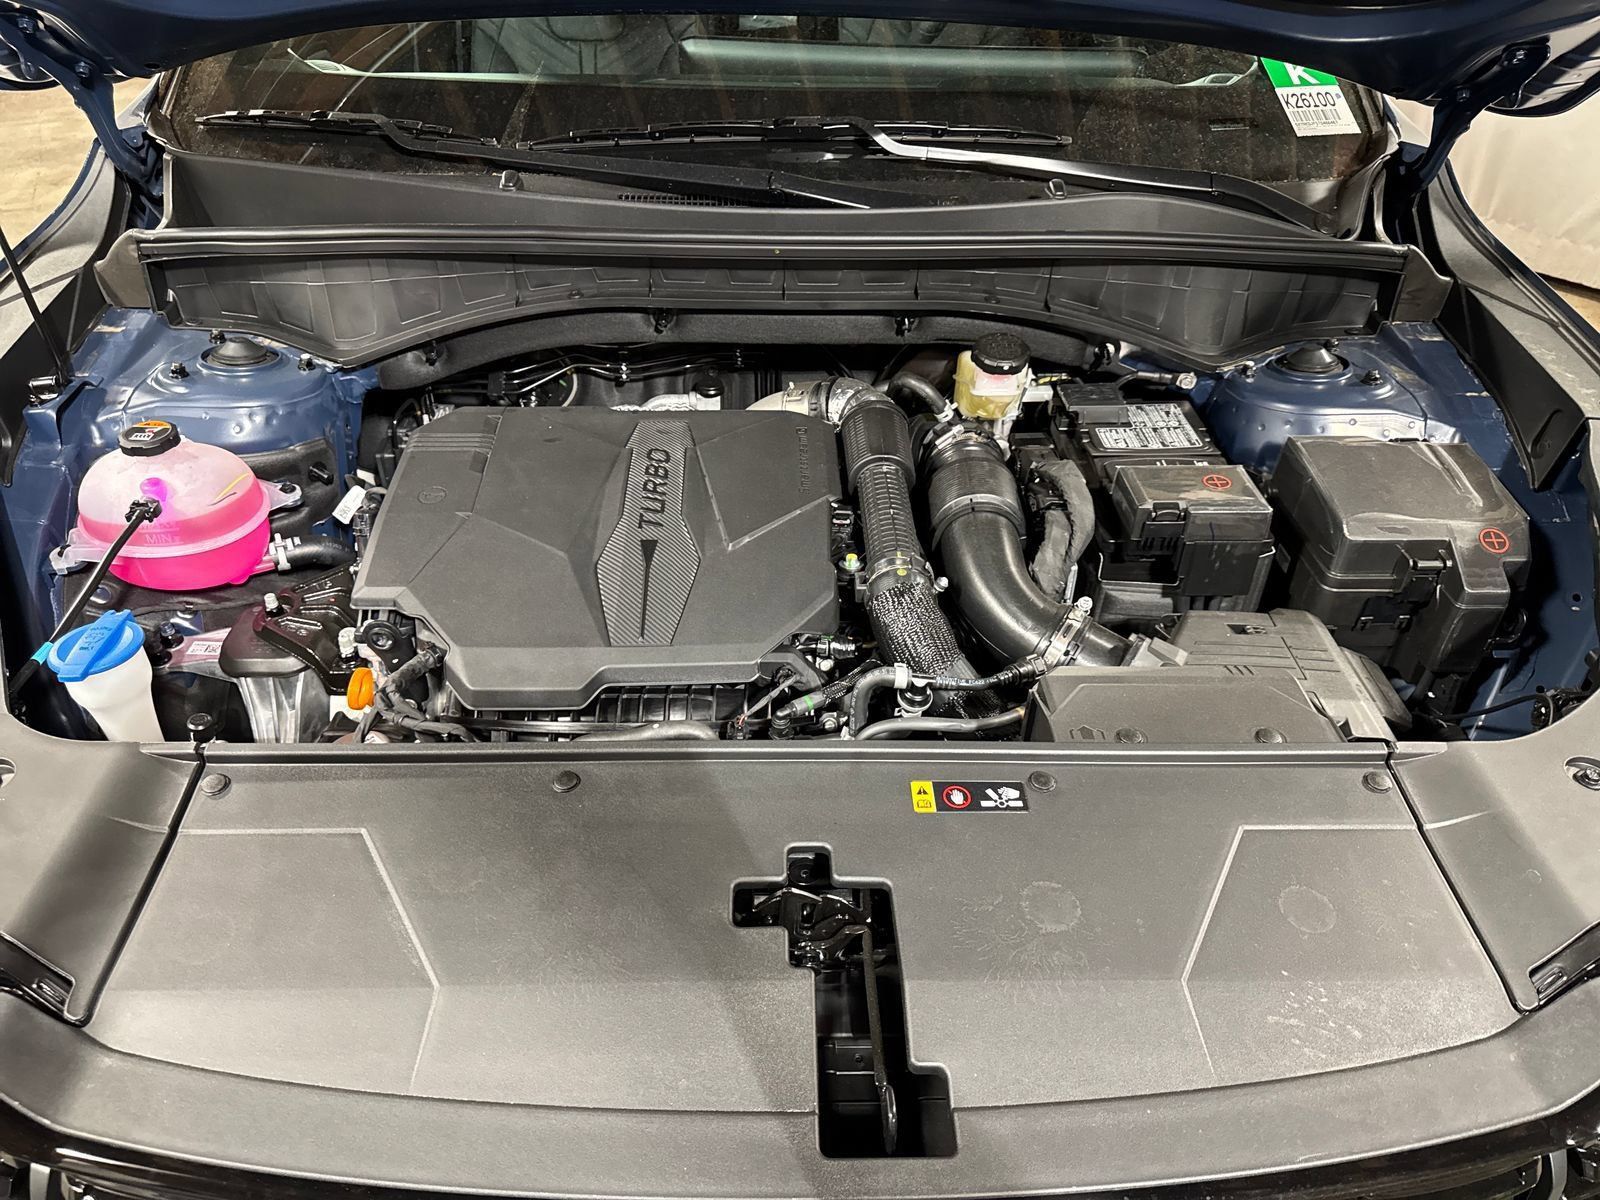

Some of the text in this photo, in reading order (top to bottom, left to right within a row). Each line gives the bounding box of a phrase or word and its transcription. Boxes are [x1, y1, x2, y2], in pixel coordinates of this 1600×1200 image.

[1284, 62, 1320, 84] K
[1281, 92, 1336, 109] K26100
[638, 448, 671, 529] TURBO
[145, 533, 172, 544] MIN
